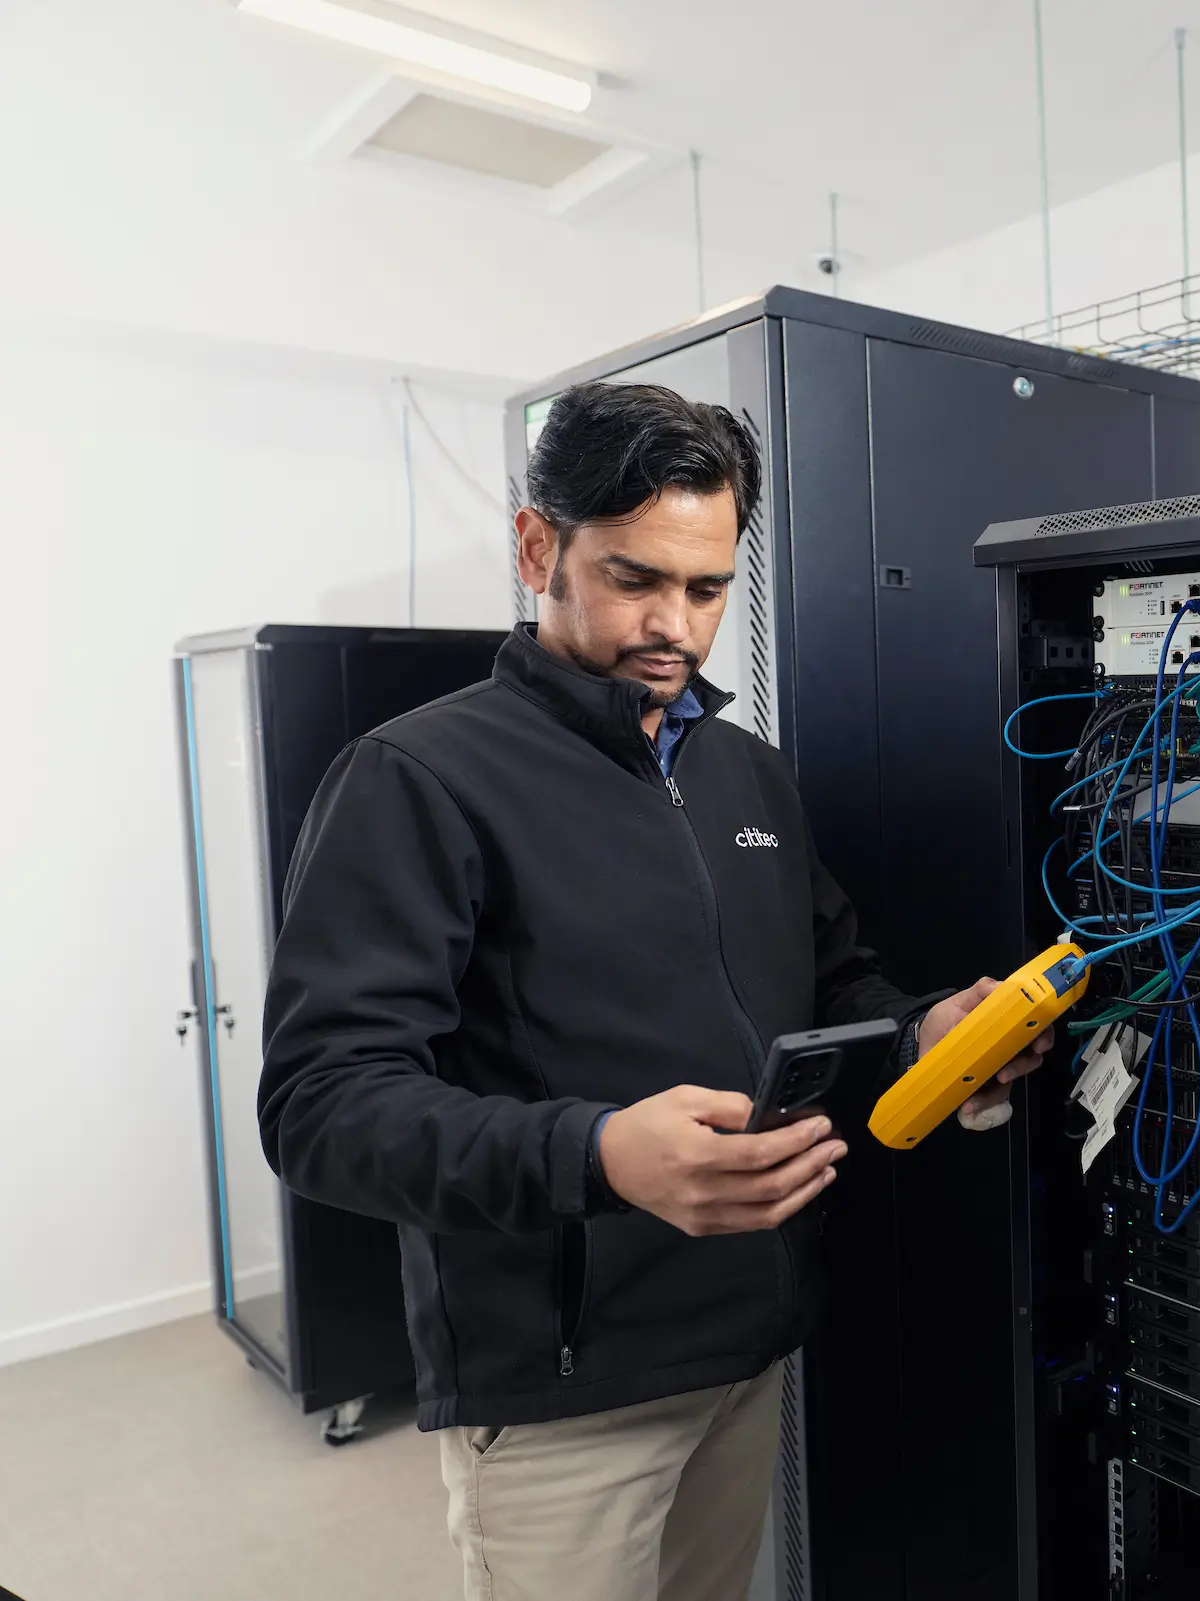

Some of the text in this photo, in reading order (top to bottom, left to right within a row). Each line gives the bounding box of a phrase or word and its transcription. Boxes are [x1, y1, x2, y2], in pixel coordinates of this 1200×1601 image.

[1129, 581, 1163, 590] FORTINET
[1131, 631, 1165, 639] FORTINET
[735, 826, 779, 848] cititec
